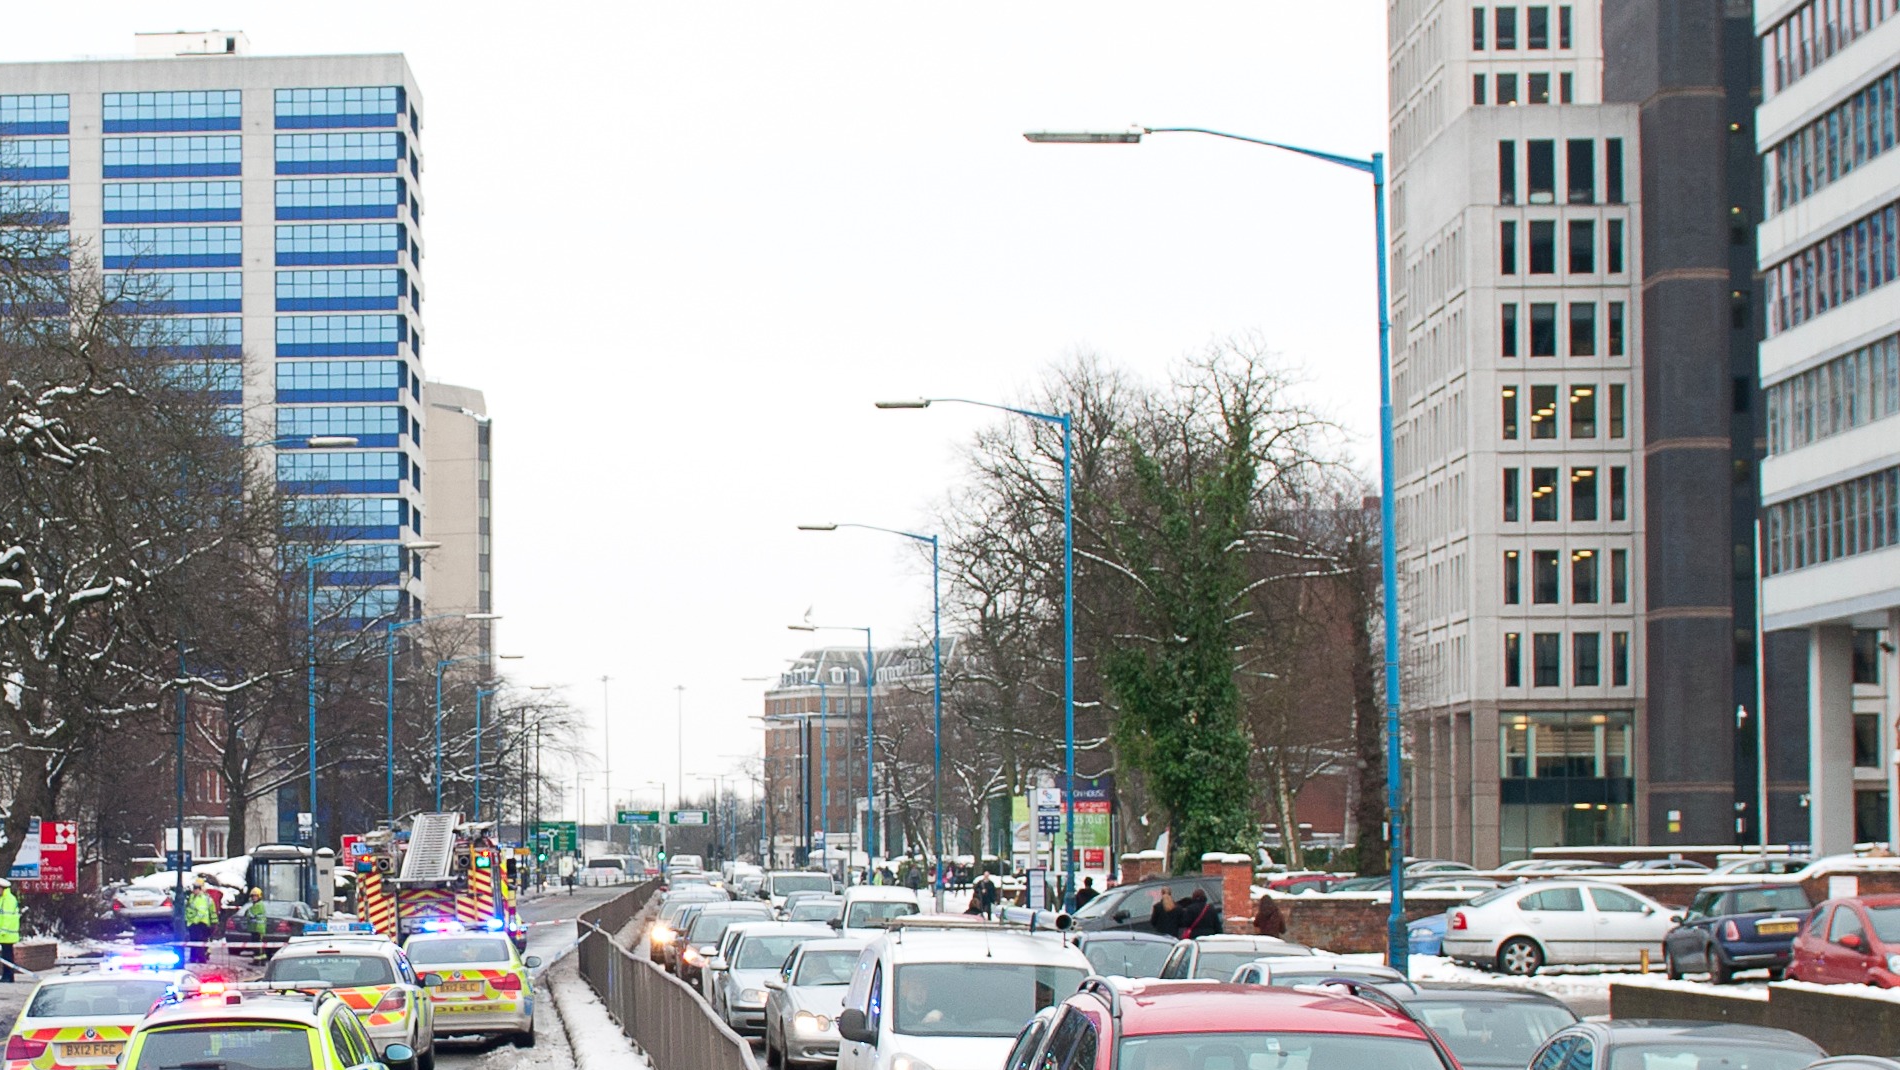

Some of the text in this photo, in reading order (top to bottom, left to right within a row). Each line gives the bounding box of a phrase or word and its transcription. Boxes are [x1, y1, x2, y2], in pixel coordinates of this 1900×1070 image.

[434, 1004, 501, 1013] OLICE
[66, 1044, 116, 1056] BX12 FGC
